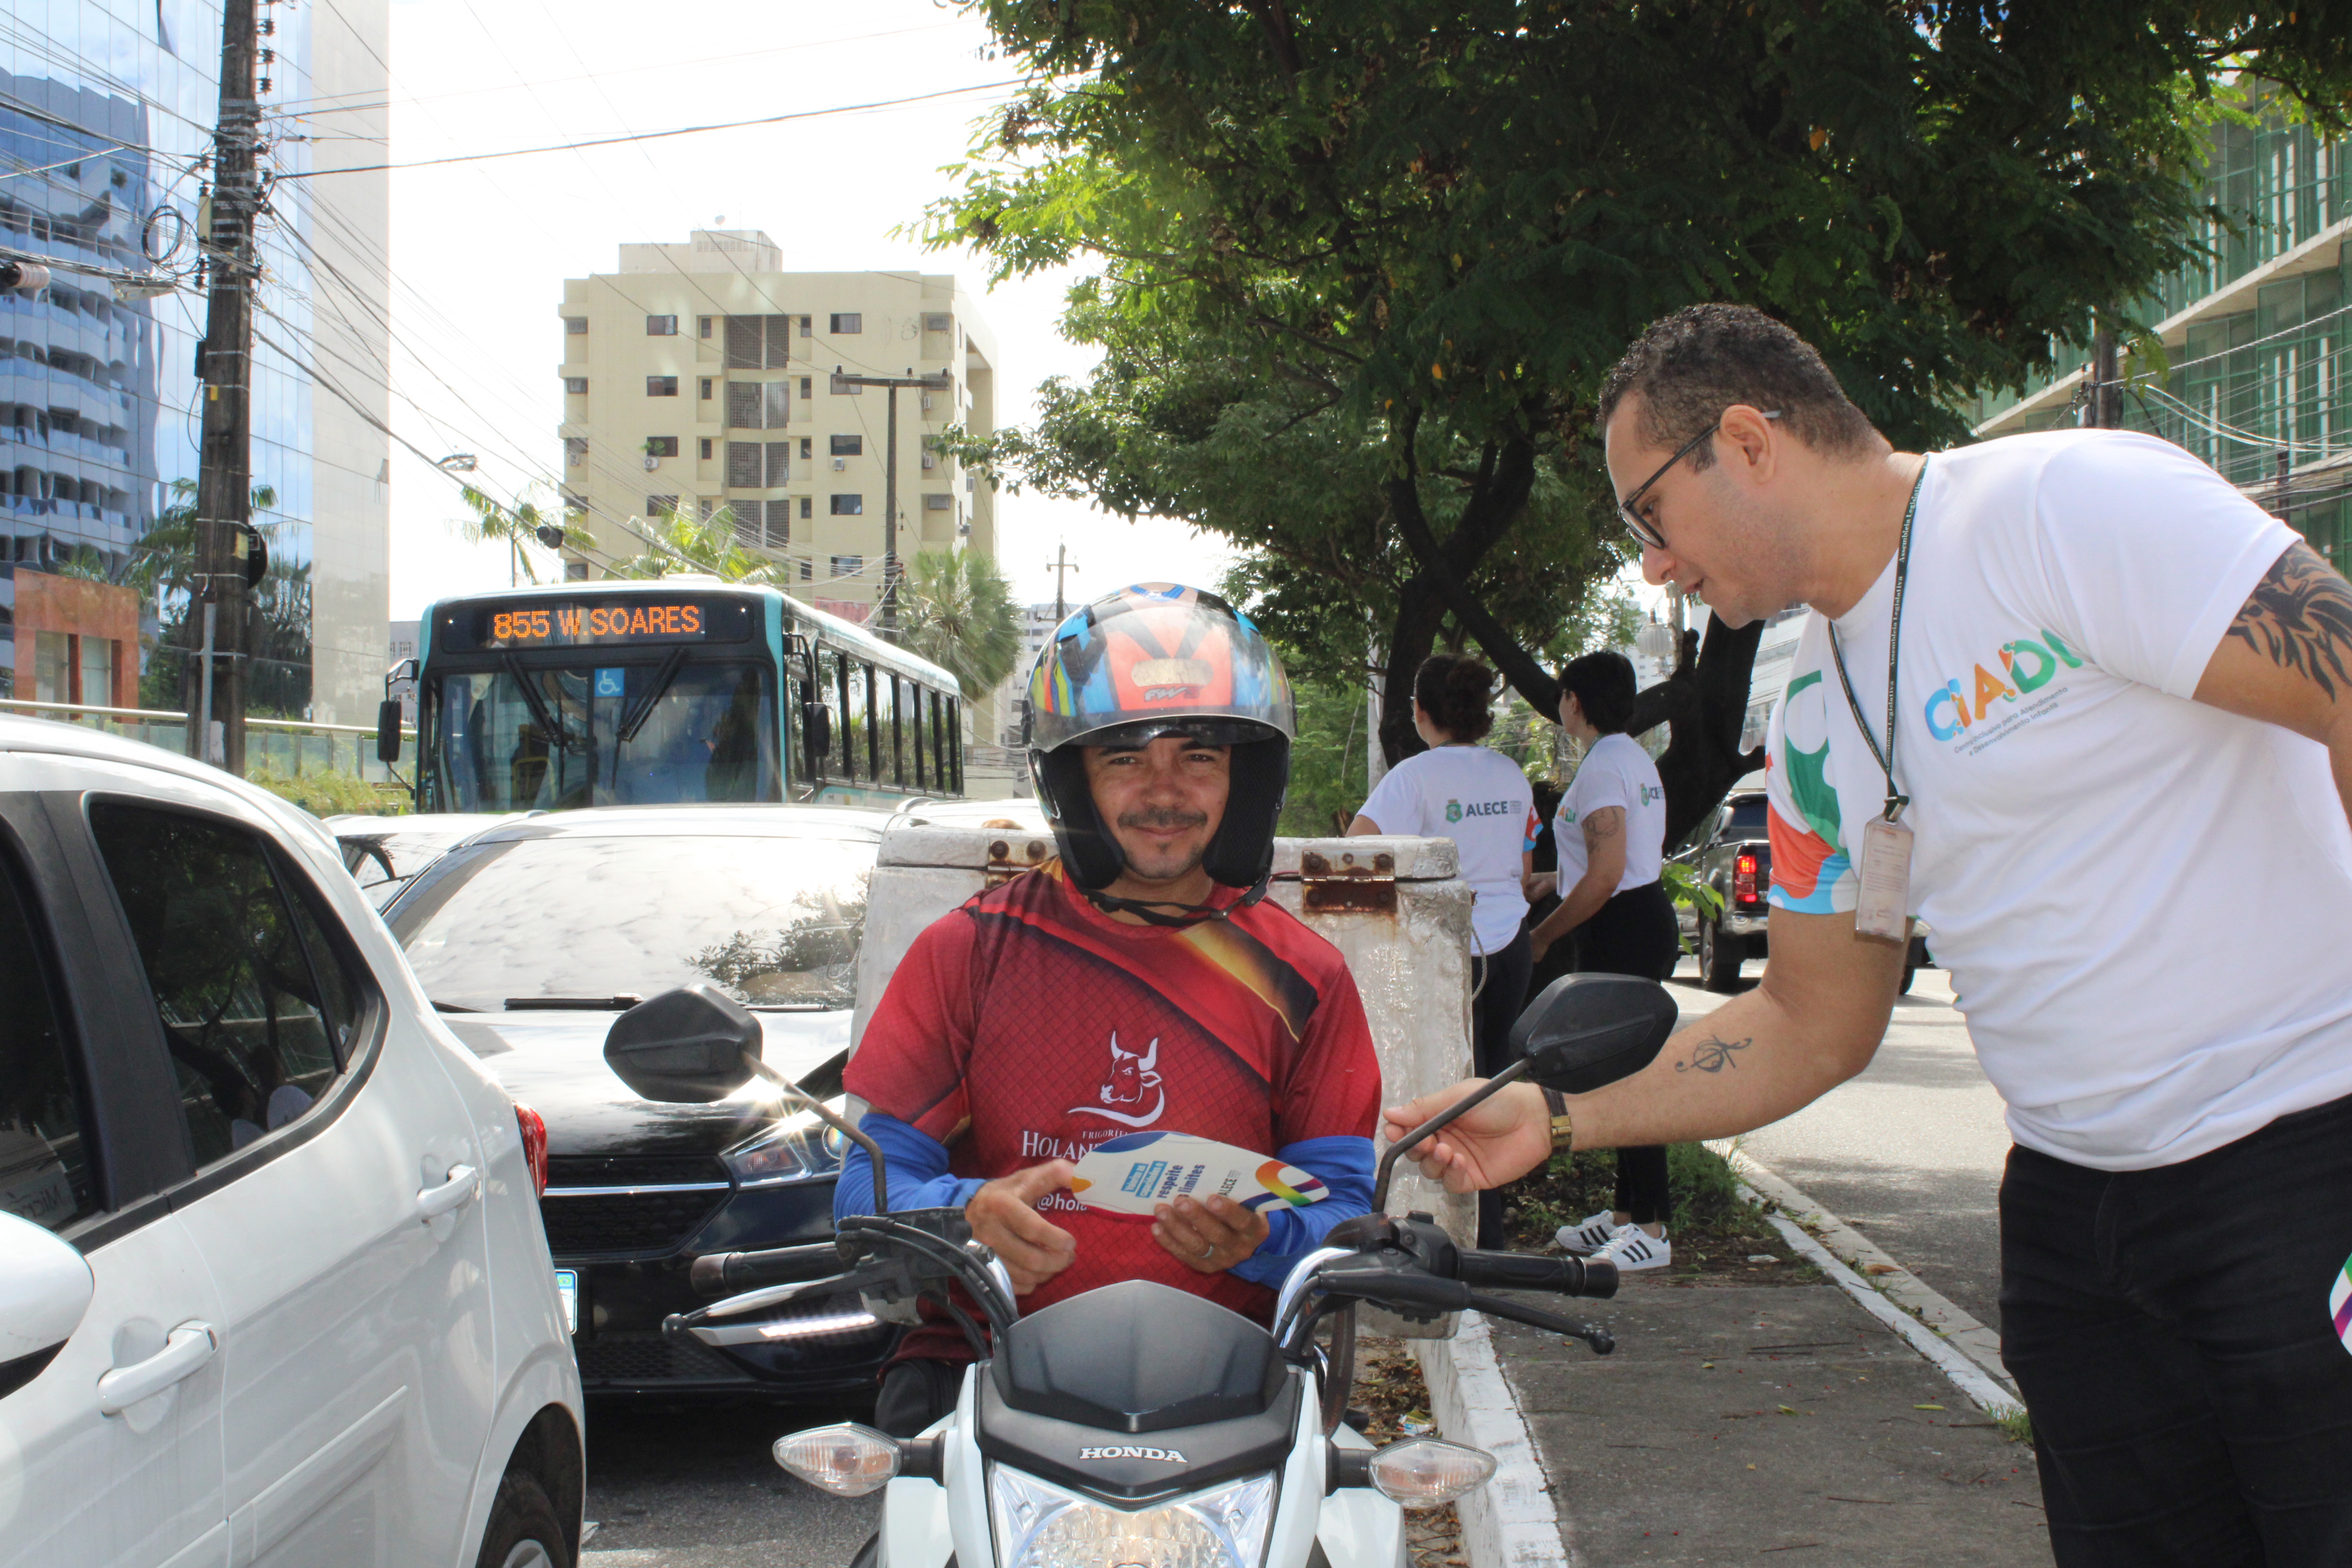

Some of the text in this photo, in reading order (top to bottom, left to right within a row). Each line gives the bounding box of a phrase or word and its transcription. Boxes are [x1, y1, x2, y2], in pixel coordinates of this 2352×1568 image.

[1898, 478, 1923, 563] Assembleia Legislativa
[494, 610, 550, 639] 855
[1890, 575, 1903, 666] Assembleia Legislativa
[2001, 713, 2020, 727] para
[2020, 687, 2069, 716] Atendimento
[1973, 717, 2030, 754] Desenvolvimento
[2030, 701, 2059, 720] Infantil
[1466, 801, 1508, 817] ALECE
[1022, 1131, 1102, 1160] HOLAN
[1157, 1165, 1184, 1198] respeite
[1178, 1164, 1206, 1194] limites
[1079, 1446, 1188, 1463] HONDA
